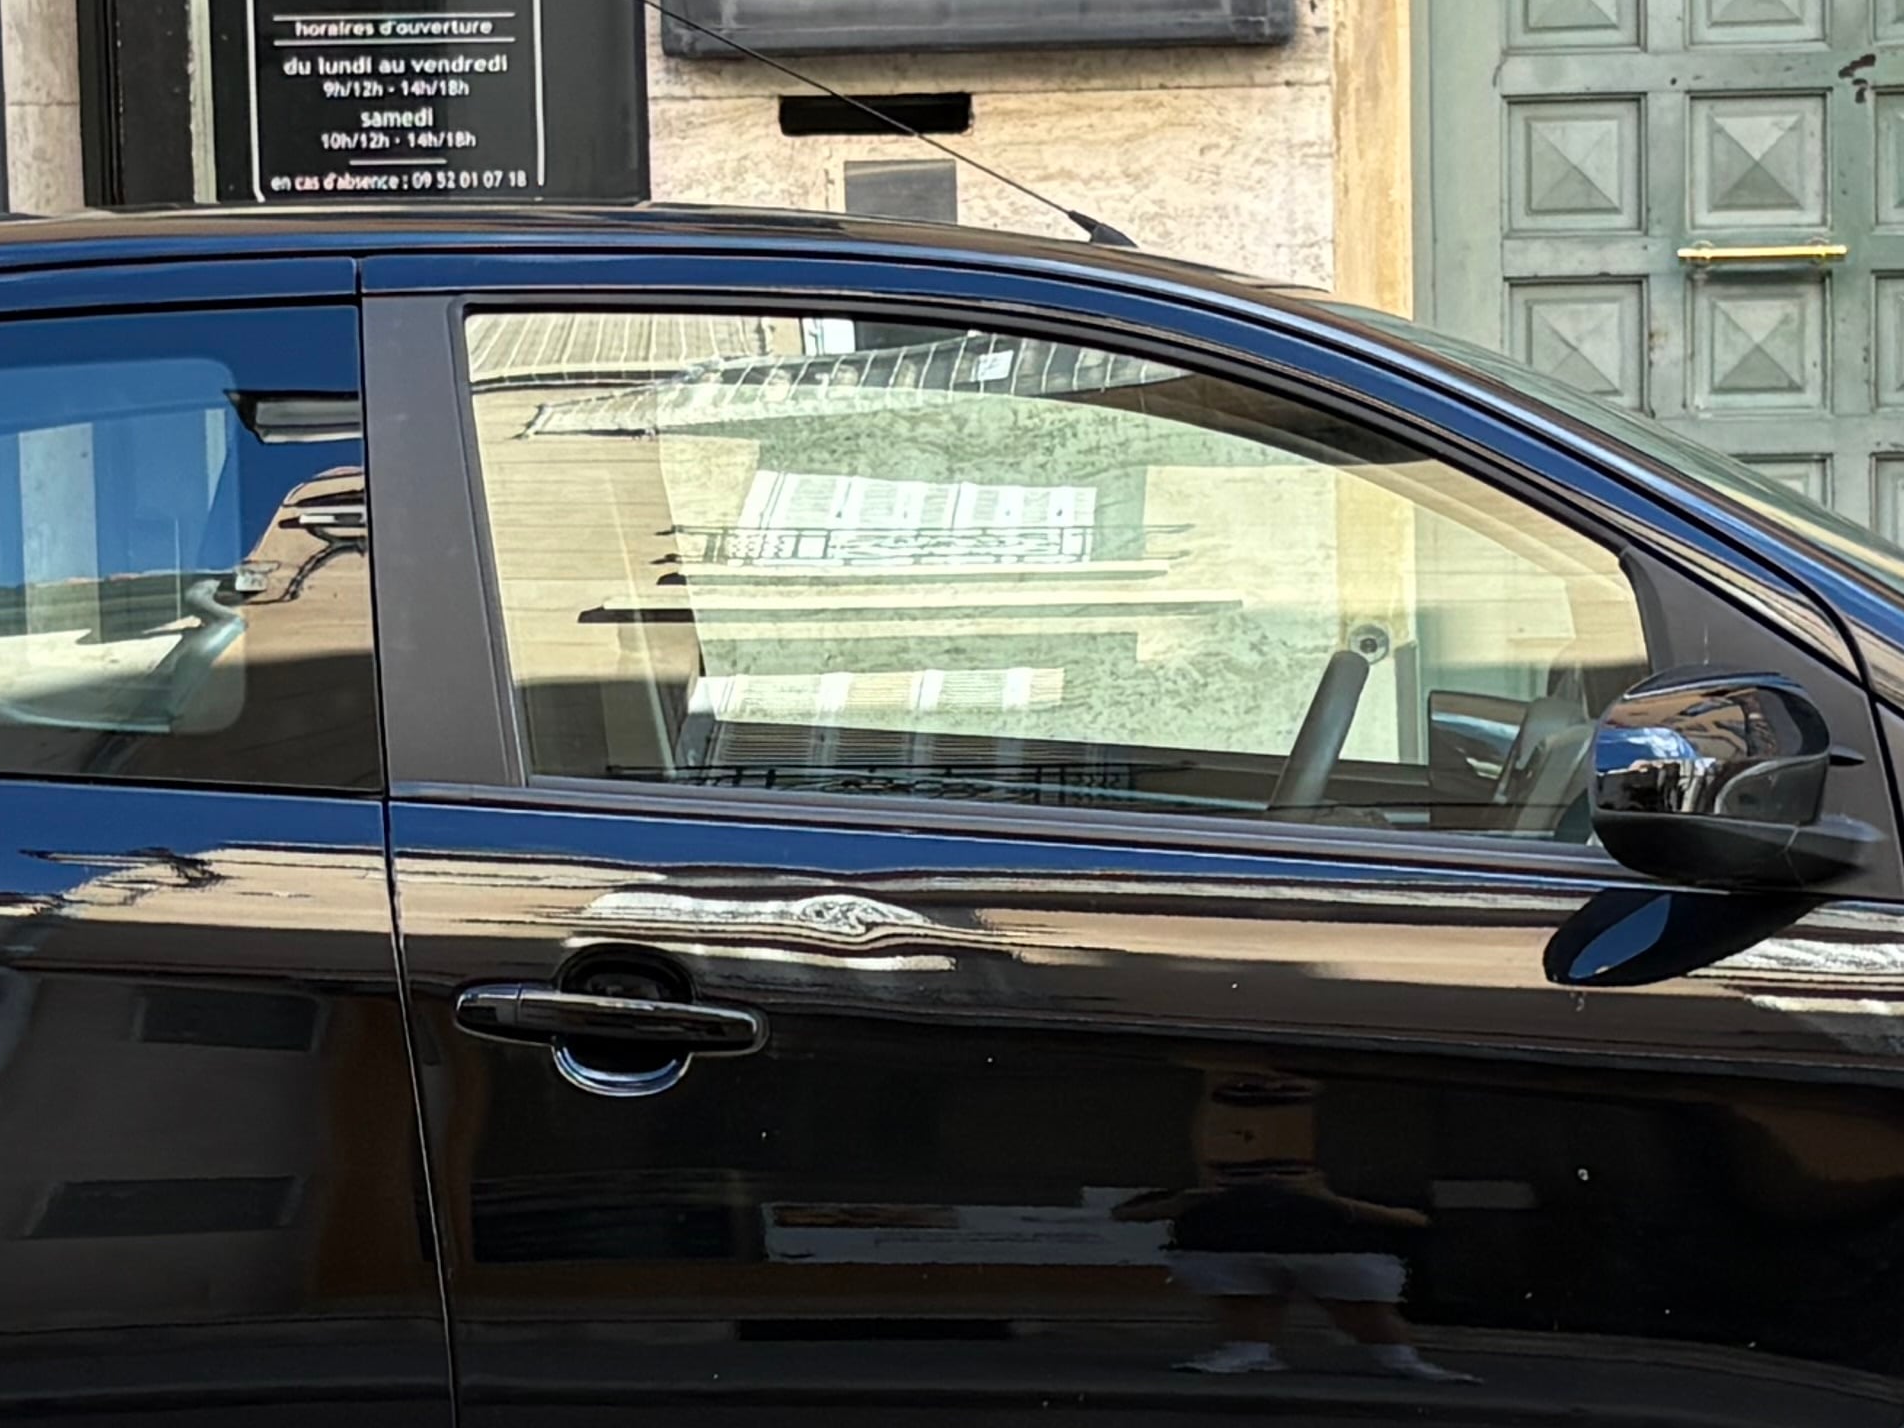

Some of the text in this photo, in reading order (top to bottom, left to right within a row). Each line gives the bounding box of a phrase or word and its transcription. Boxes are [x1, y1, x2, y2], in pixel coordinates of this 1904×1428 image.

[295, 19, 492, 37] horaires d'ouverture
[283, 54, 508, 75] du lundi au vendredi
[323, 80, 383, 98] 9h/12h
[400, 79, 469, 97] 14h/18h
[361, 107, 433, 127] samedi
[321, 133, 390, 150] 10h/12h
[408, 132, 476, 149] 14h/18h
[271, 177, 291, 191] en
[295, 176, 319, 191] cas
[323, 172, 399, 191] d'absence
[412, 173, 431, 189] 09
[460, 172, 478, 189] 01
[483, 172, 502, 188] 07
